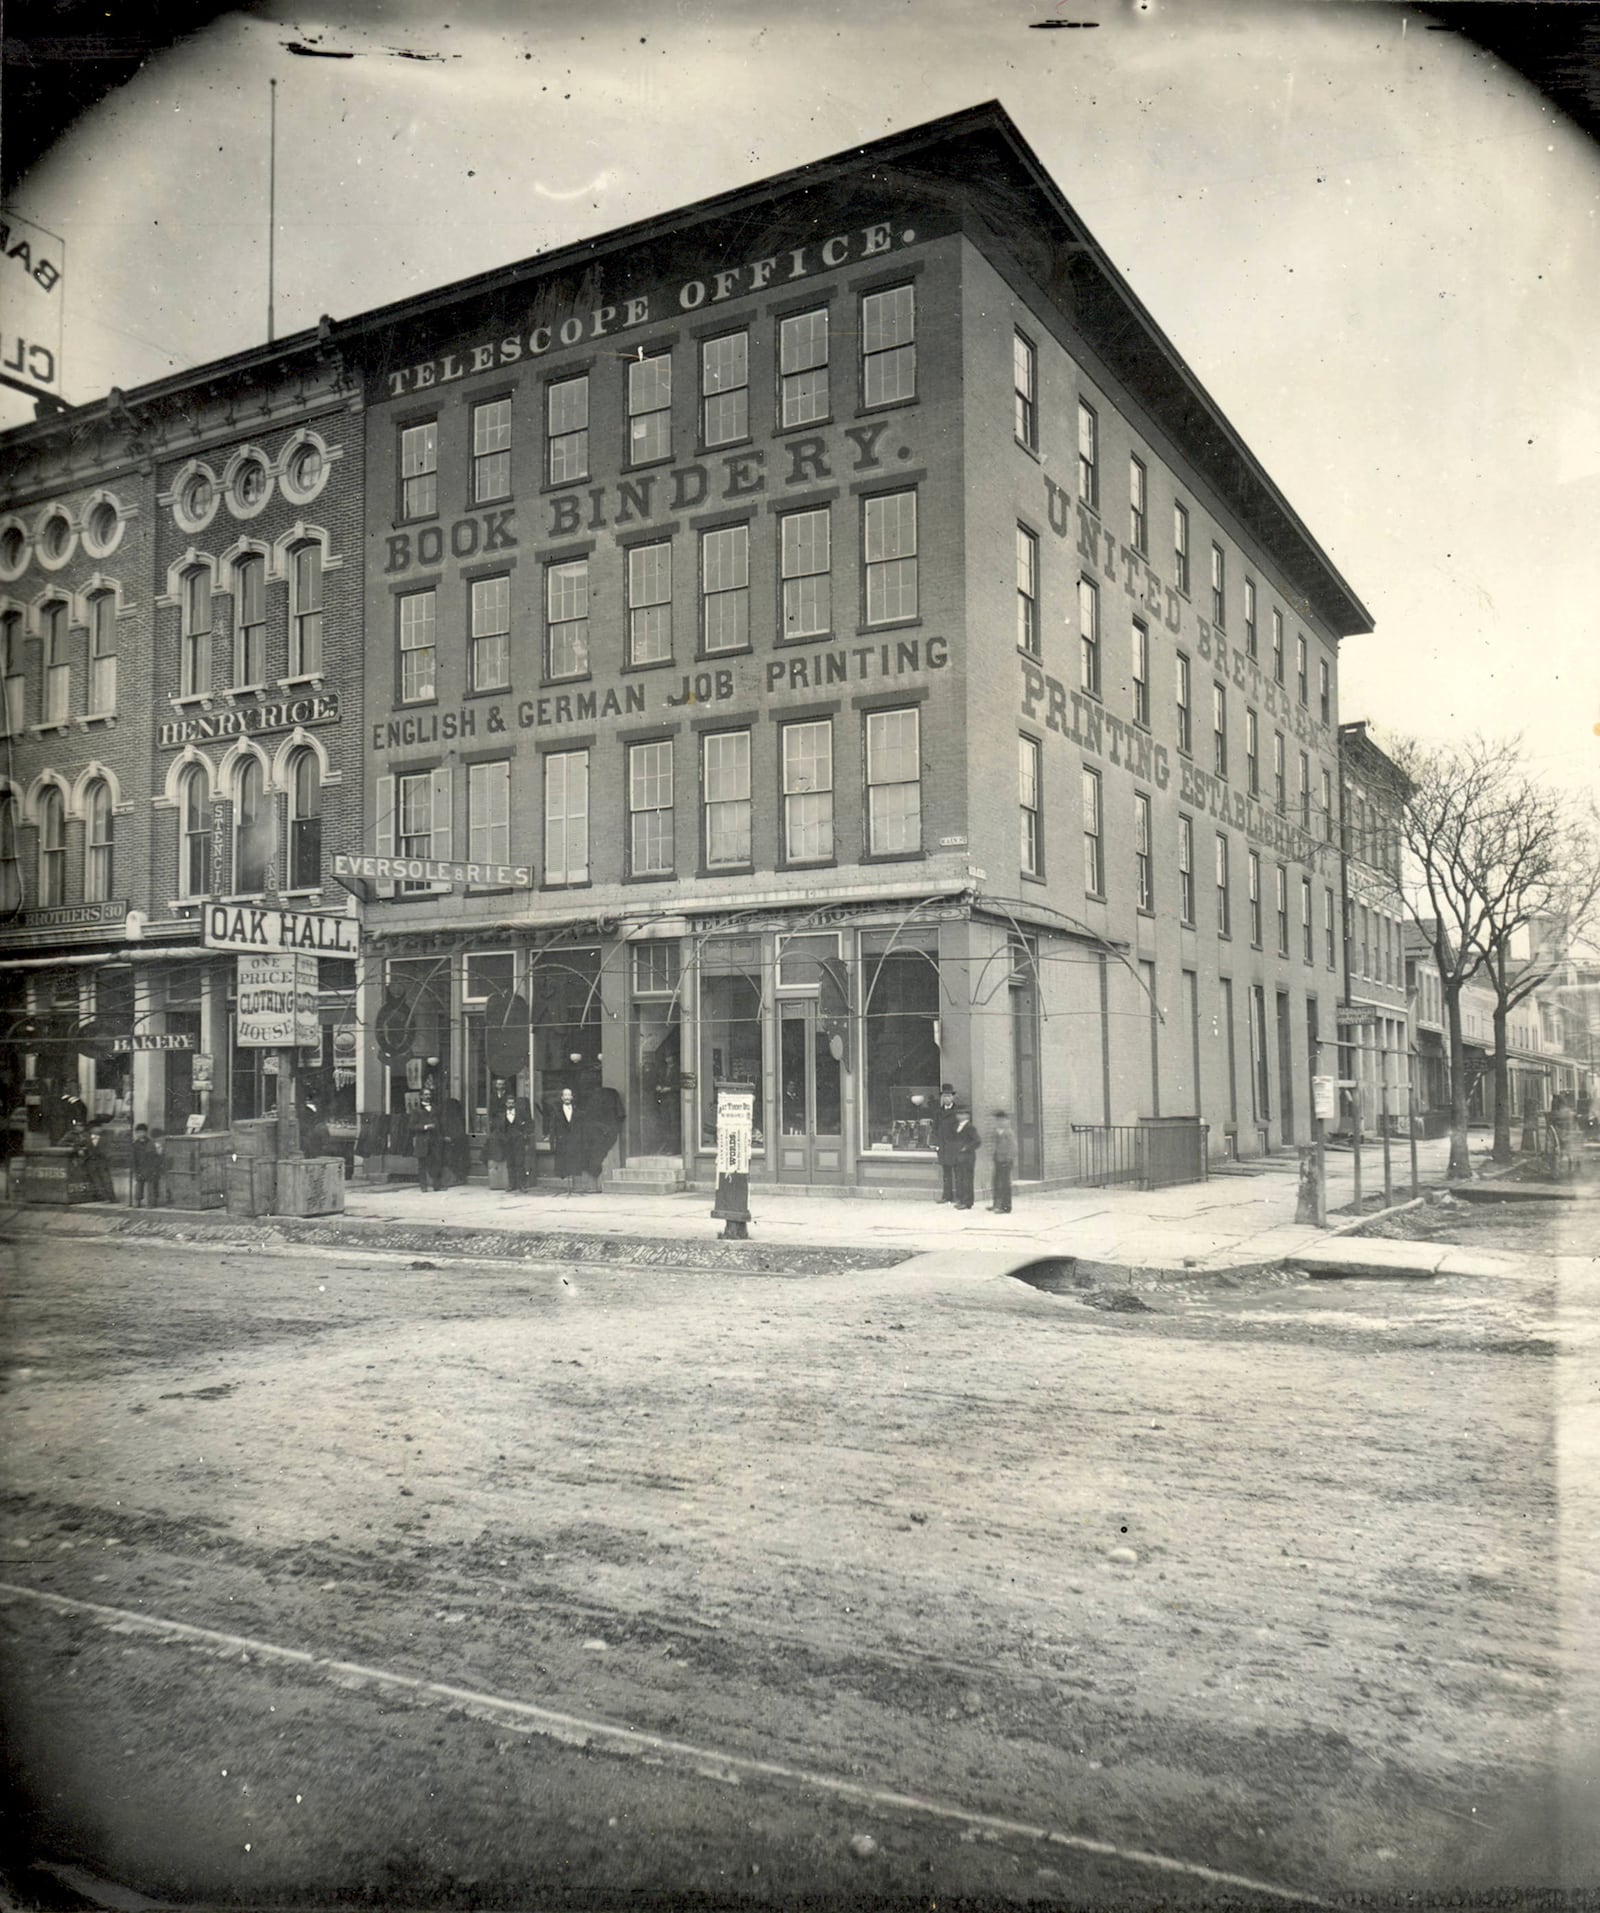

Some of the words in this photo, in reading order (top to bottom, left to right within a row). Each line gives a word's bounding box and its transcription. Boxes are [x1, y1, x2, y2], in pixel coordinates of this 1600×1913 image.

[388, 295, 650, 397] TELESCOPE
[678, 221, 916, 309] OFFICE.
[384, 508, 518, 574] BOOK
[548, 420, 914, 538] BINDERY.
[1044, 474, 1181, 635] UNITED
[1196, 614, 1328, 752] BRETHREN
[372, 706, 476, 751] ENGLISH
[487, 706, 507, 734] &
[517, 683, 646, 729] GERMAN
[667, 669, 735, 707] JOB
[765, 636, 948, 693] PRINTING
[160, 709, 253, 745] HENRY
[1021, 659, 1170, 791] PRINTING
[213, 804, 224, 896] STENCIL
[335, 855, 450, 880] EVERSOLE
[455, 867, 464, 882] &
[467, 864, 529, 886] RIES
[25, 906, 101, 927] BROTHERS
[105, 904, 122, 919] 30
[211, 906, 268, 945] OAK
[279, 913, 357, 953] HALL.
[239, 971, 292, 985] PRICE
[251, 957, 280, 969] ONE
[239, 989, 294, 1015] CLOTHING
[113, 1034, 193, 1051] BAKERY
[239, 1020, 293, 1041] HOUSE
